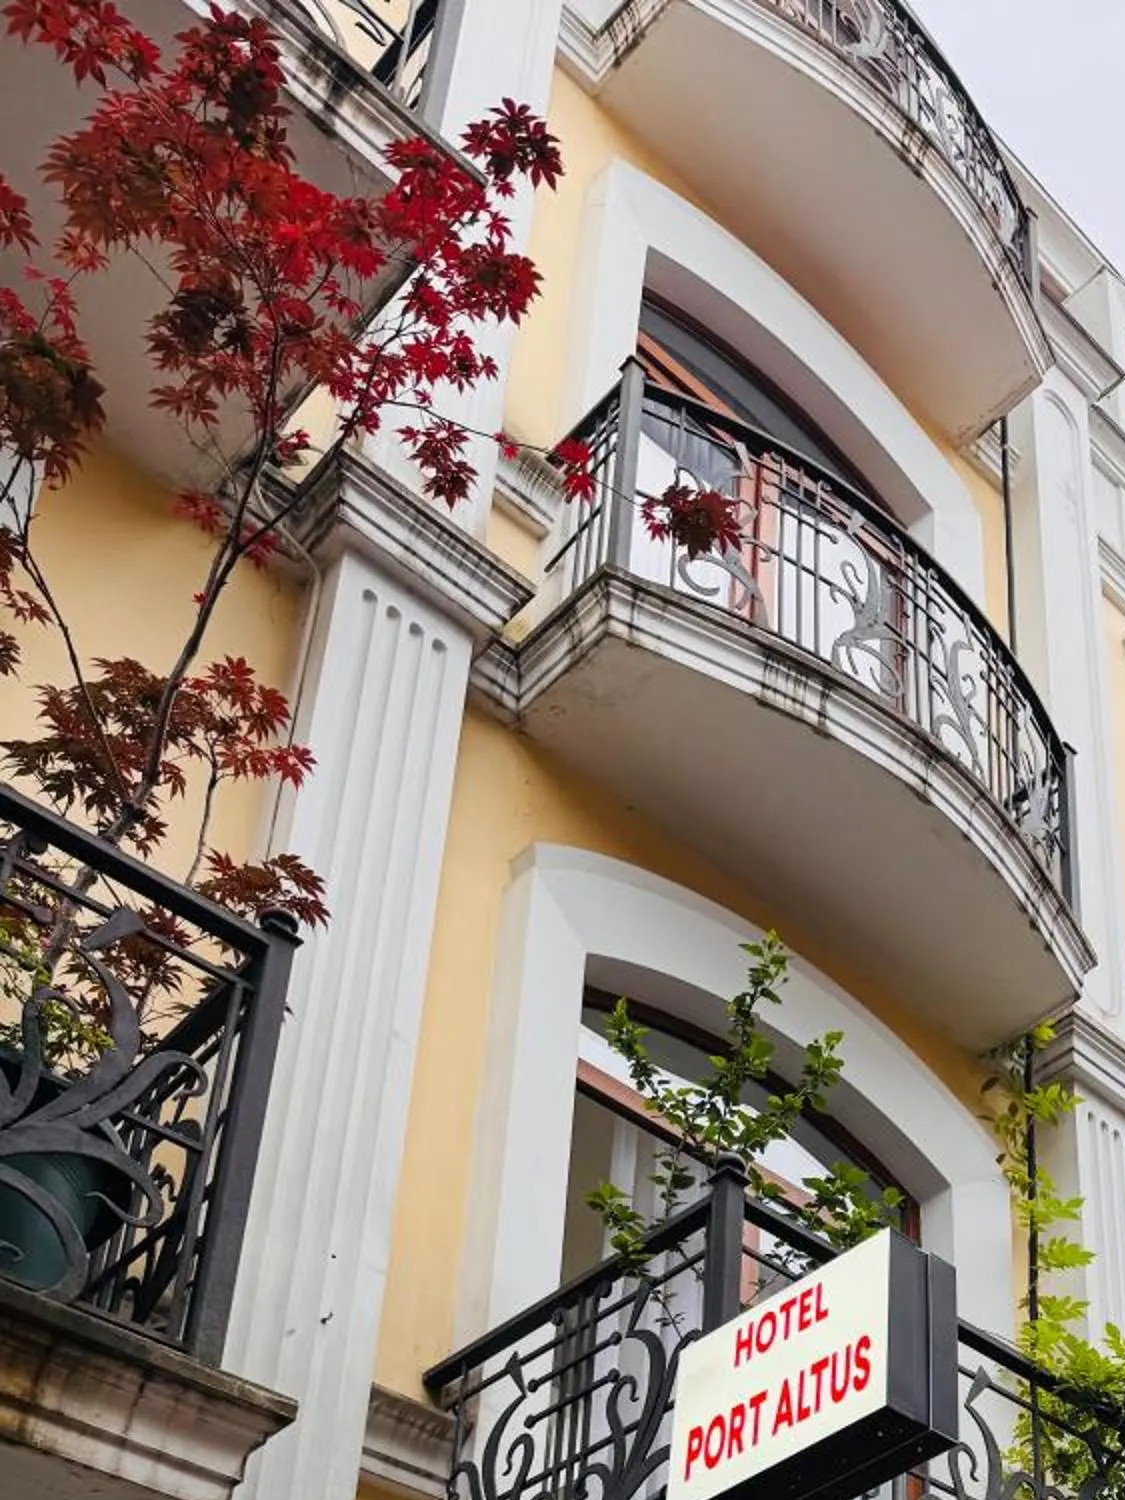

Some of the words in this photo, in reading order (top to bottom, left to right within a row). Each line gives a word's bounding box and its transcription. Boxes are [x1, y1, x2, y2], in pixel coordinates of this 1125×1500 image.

[733, 1282, 829, 1368] HOTEL
[684, 1390, 768, 1482] PORT
[772, 1335, 871, 1436] ALTUS
